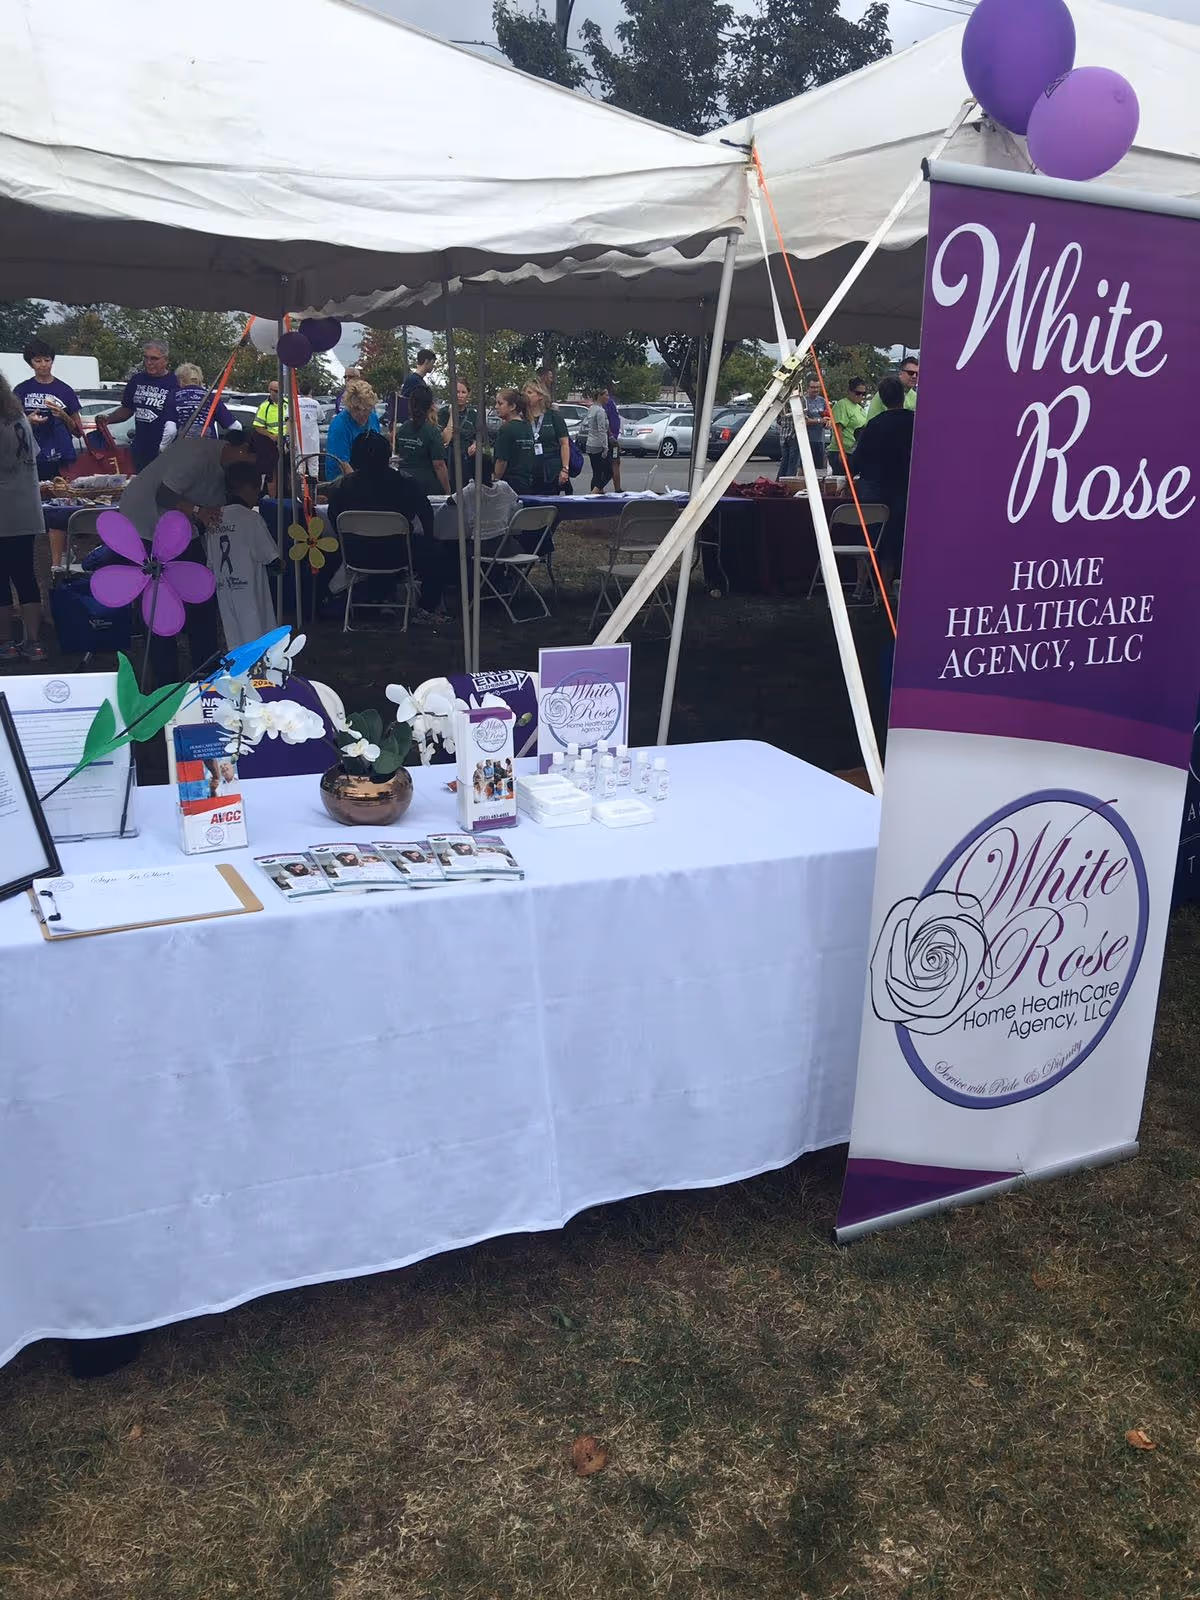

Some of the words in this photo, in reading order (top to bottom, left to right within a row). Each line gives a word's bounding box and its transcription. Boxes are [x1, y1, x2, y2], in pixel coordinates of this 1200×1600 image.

[931, 222, 1167, 377] White
[145, 398, 165, 408] me
[1006, 385, 1196, 523] Rose
[1010, 557, 1104, 591] HOME
[945, 595, 1154, 637] HEALTHCARE
[938, 639, 1075, 680] AGENCY,
[1084, 634, 1143, 665] LLC
[474, 674, 511, 686] END
[564, 677, 613, 701] White
[570, 699, 616, 720] Rose
[955, 799, 1128, 920] White
[976, 902, 1129, 1000] Rose
[963, 1004, 1016, 1031] Home
[1022, 981, 1120, 1016] HealthCare
[1008, 1011, 1078, 1040] Agency,
[1084, 999, 1112, 1023] LLC
[934, 1060, 970, 1091] Service
[966, 1082, 987, 1095] with
[989, 1076, 1020, 1096] Pride
[1023, 1071, 1040, 1086] &
[1042, 1039, 1083, 1079] Dignity
